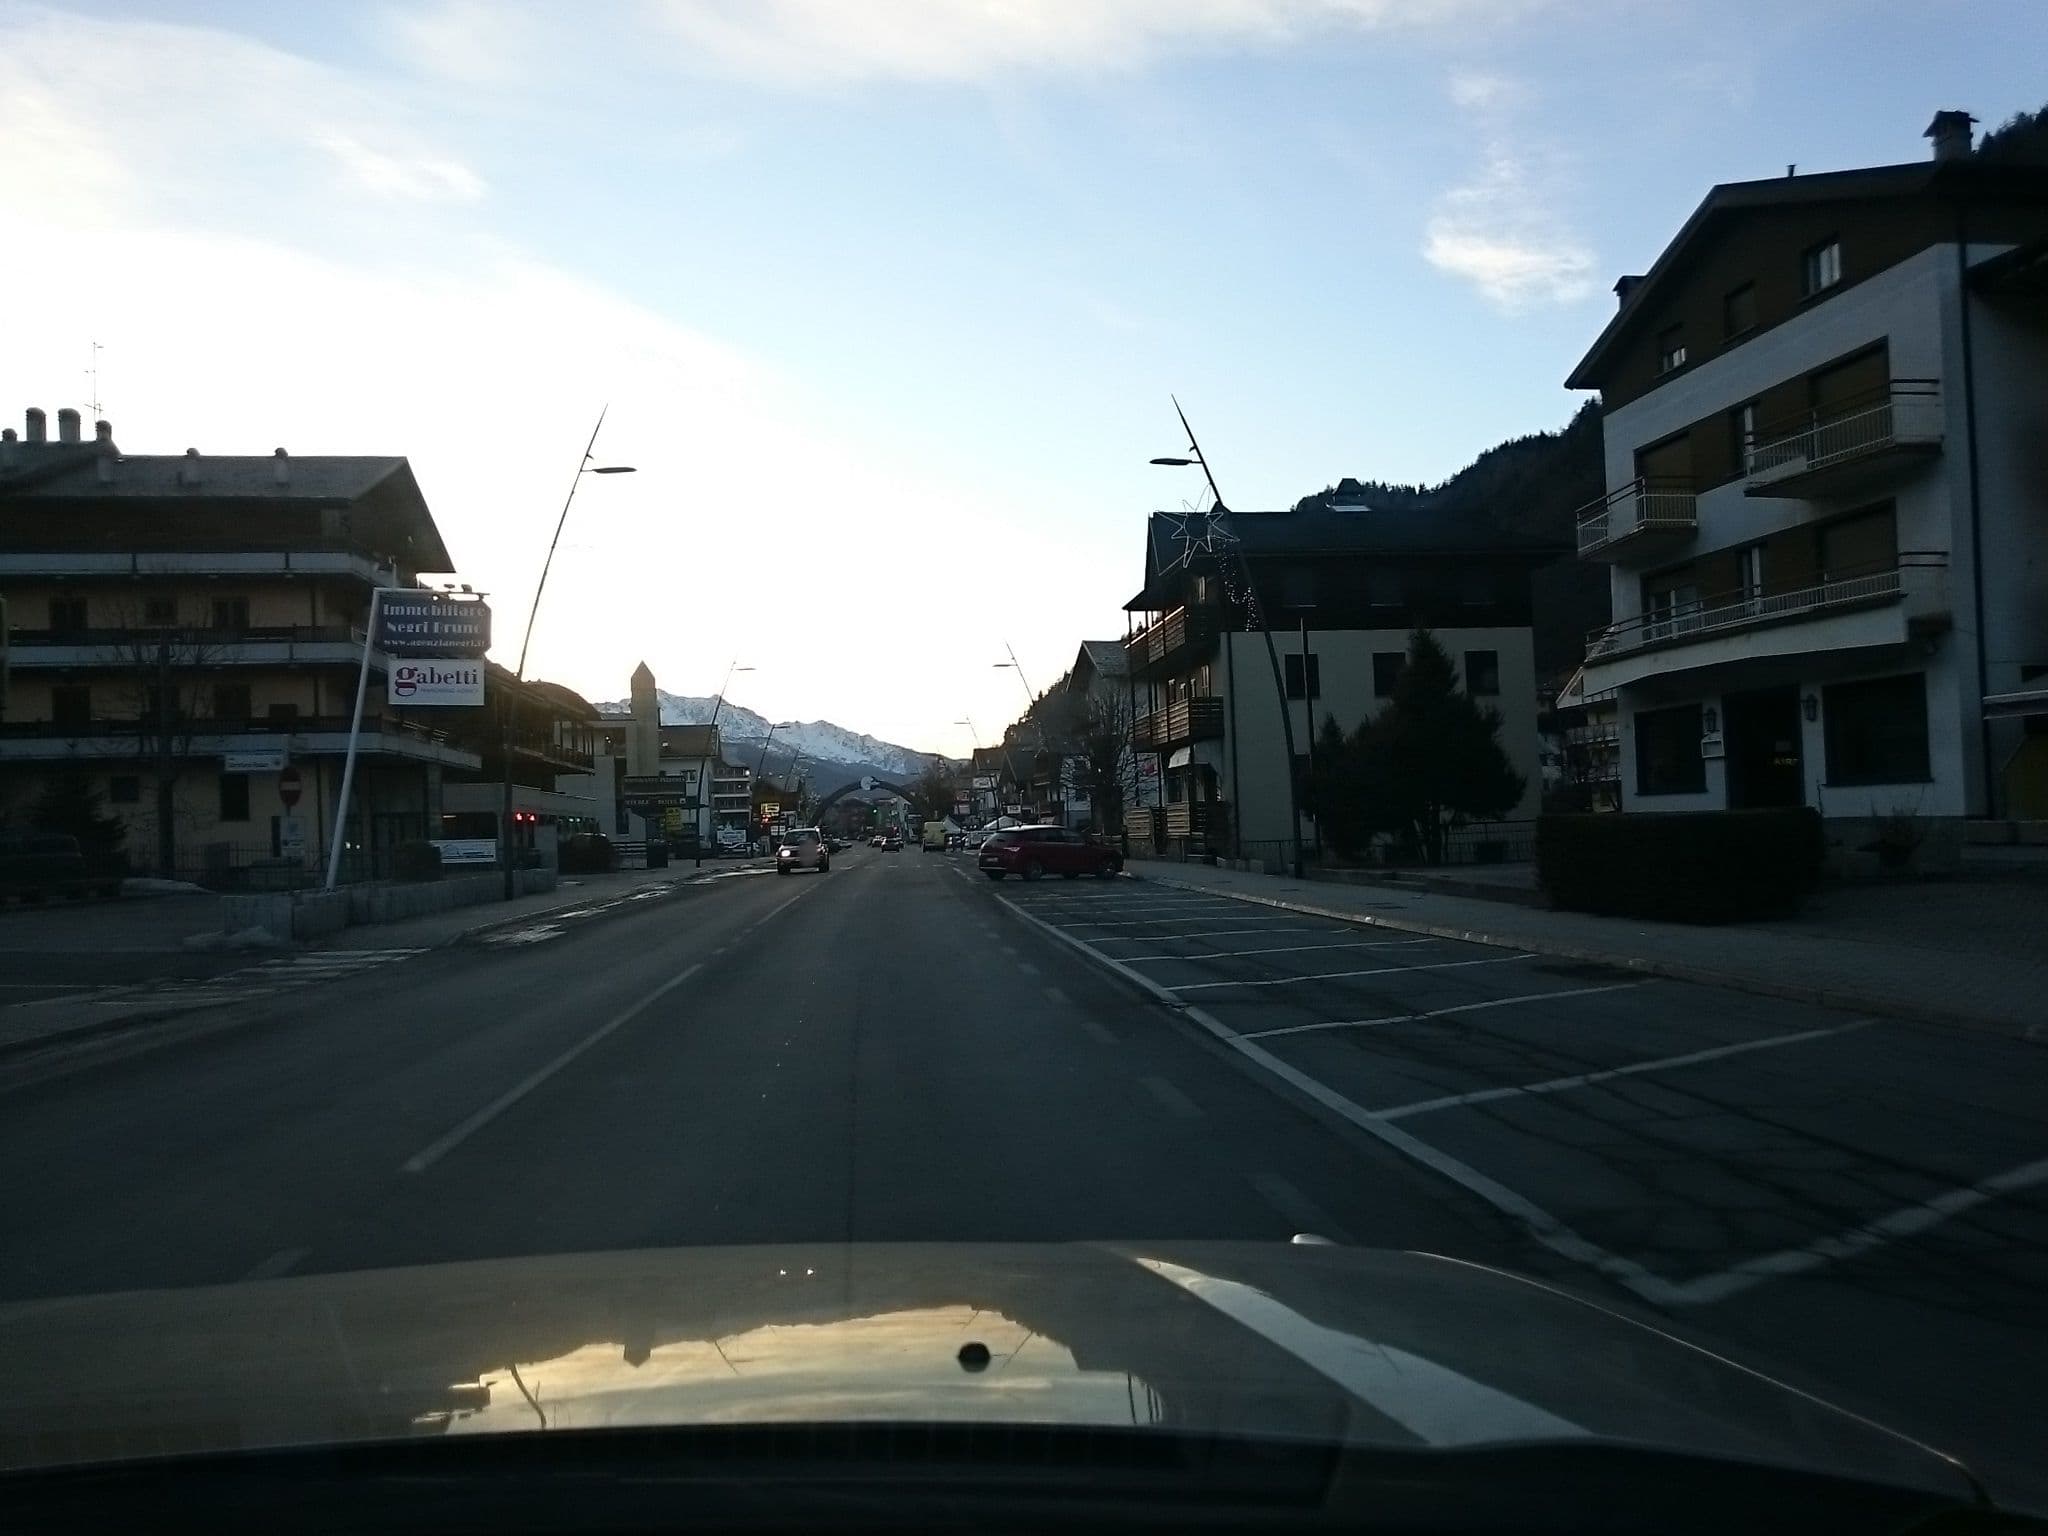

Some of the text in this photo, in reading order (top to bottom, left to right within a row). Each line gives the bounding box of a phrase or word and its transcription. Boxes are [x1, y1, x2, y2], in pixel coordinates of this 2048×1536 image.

[383, 604, 486, 617] Immobiliare
[385, 622, 482, 634] Negri Bruno
[395, 666, 479, 697] gabetti
